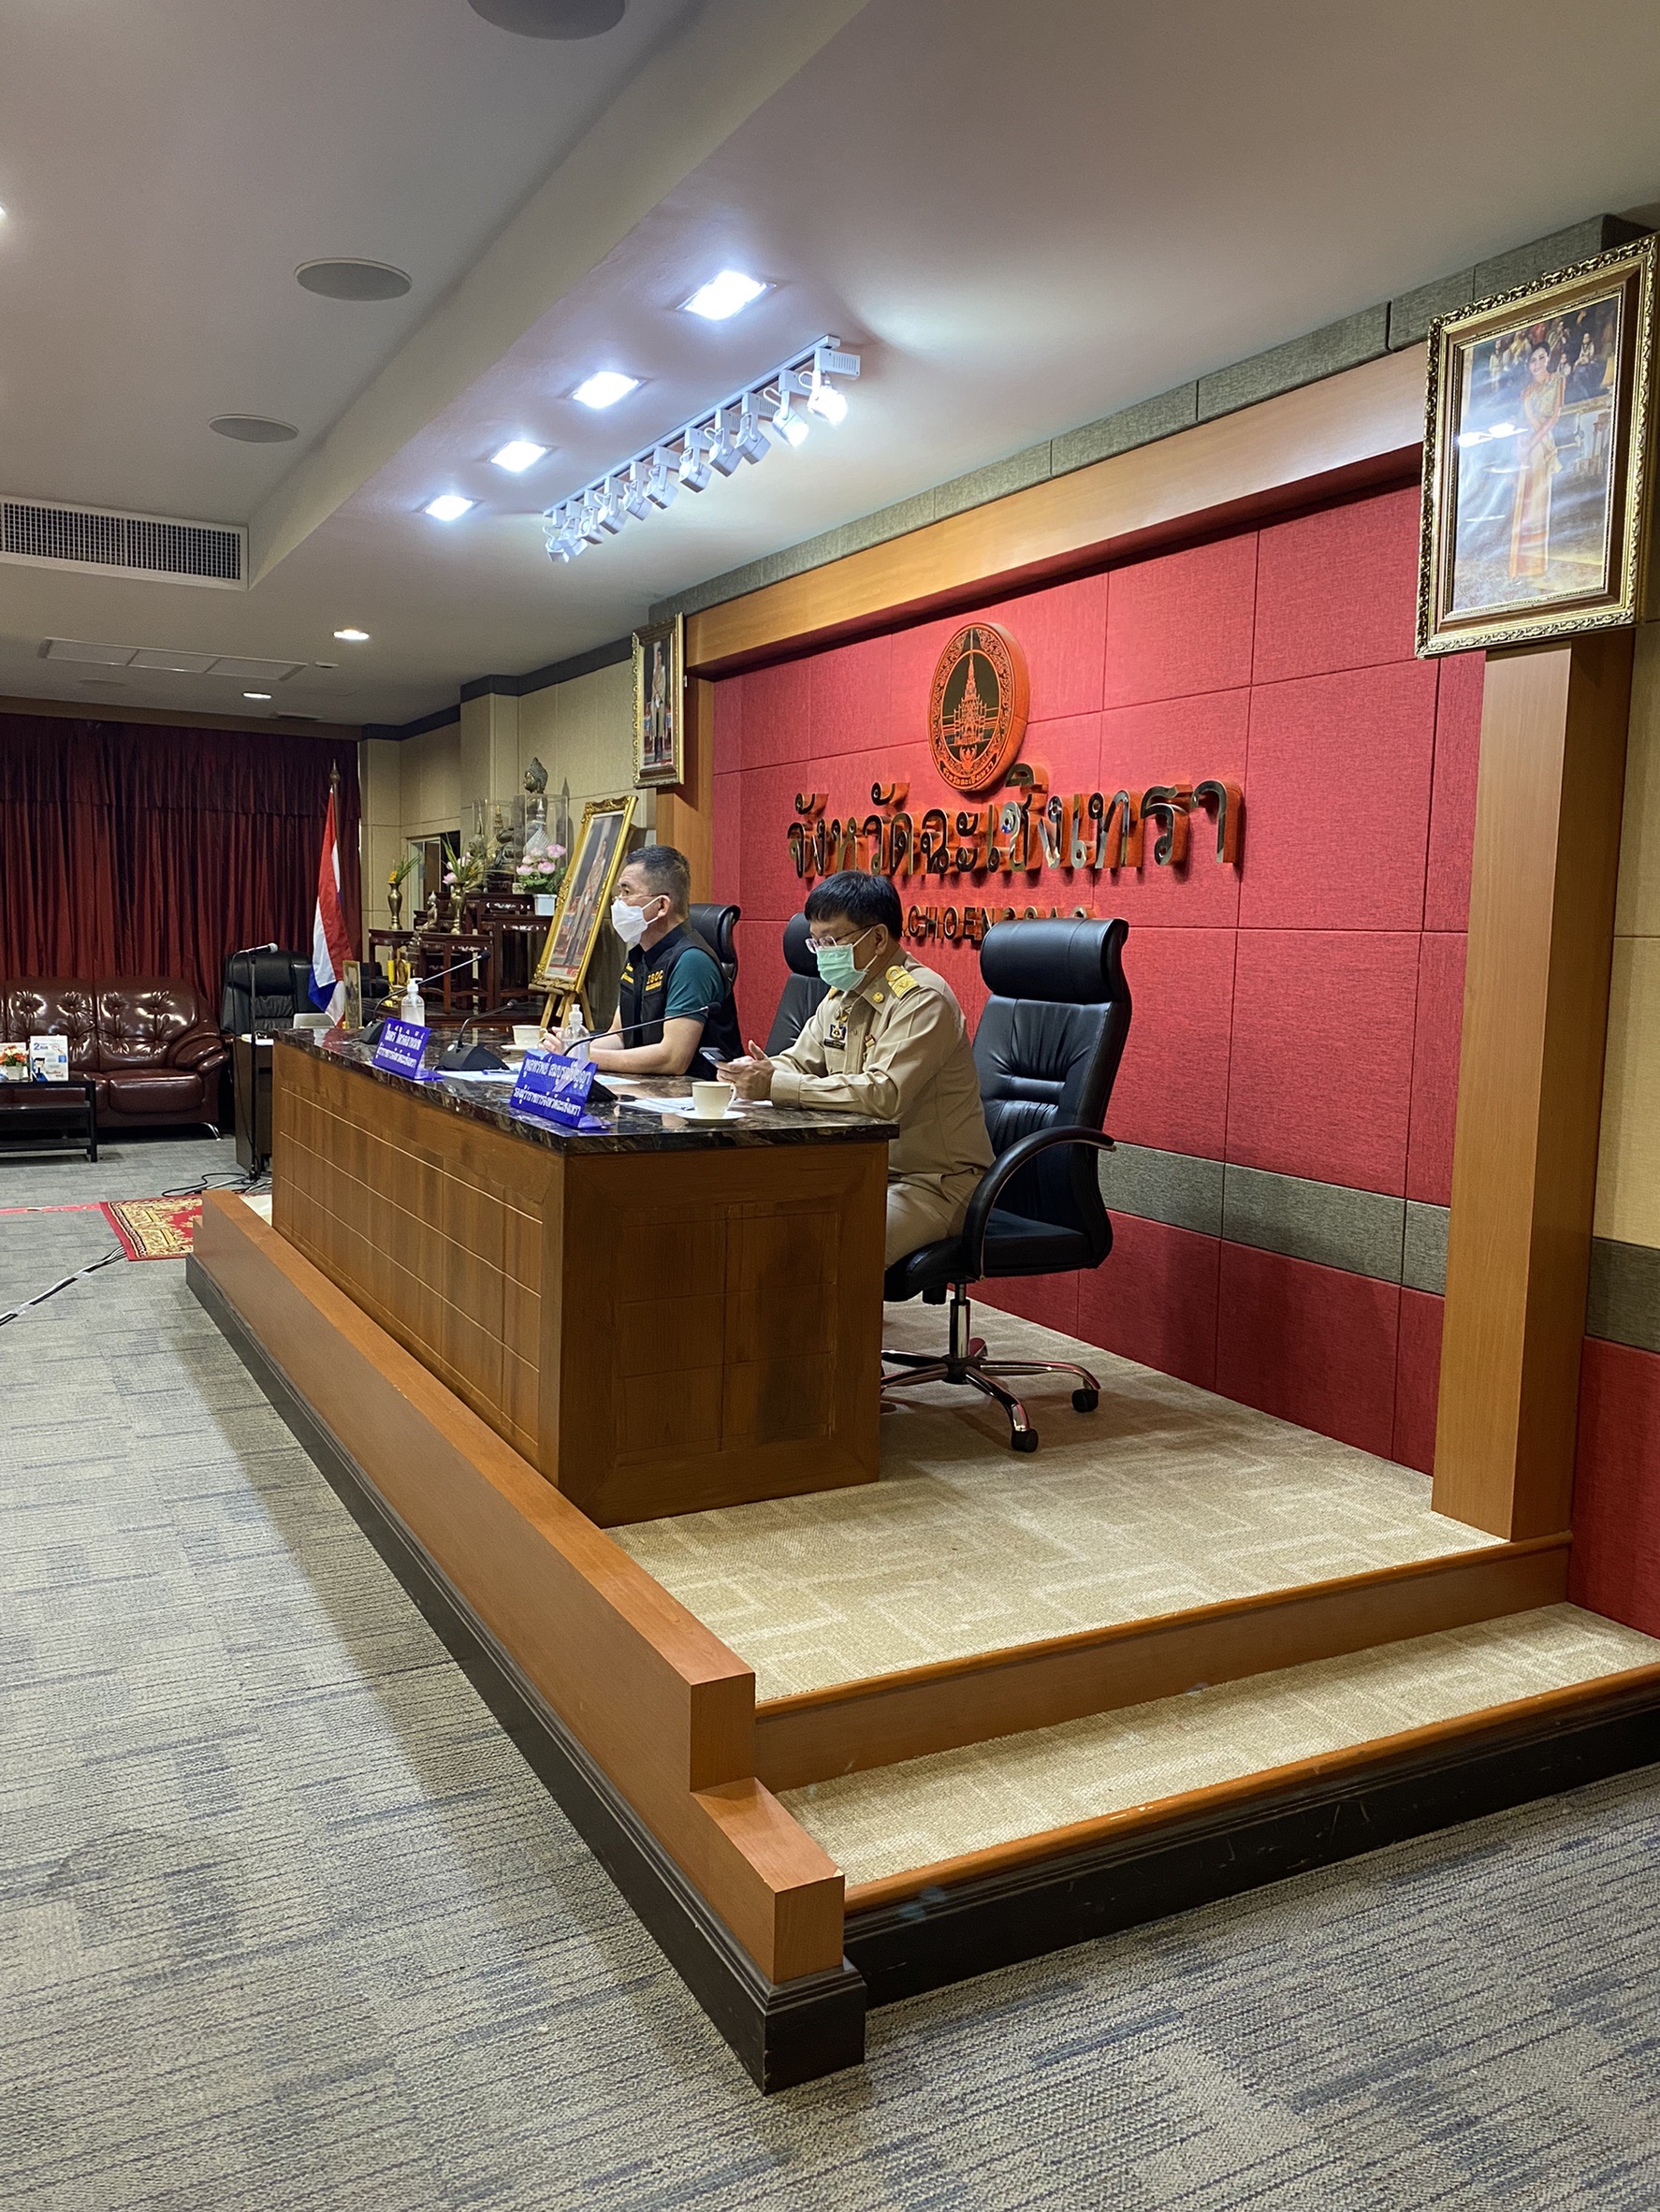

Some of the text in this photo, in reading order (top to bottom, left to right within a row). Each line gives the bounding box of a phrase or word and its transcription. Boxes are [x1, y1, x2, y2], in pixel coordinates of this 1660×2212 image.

[787, 764, 1235, 880] จังหวัดฉะเชิงเทรา
